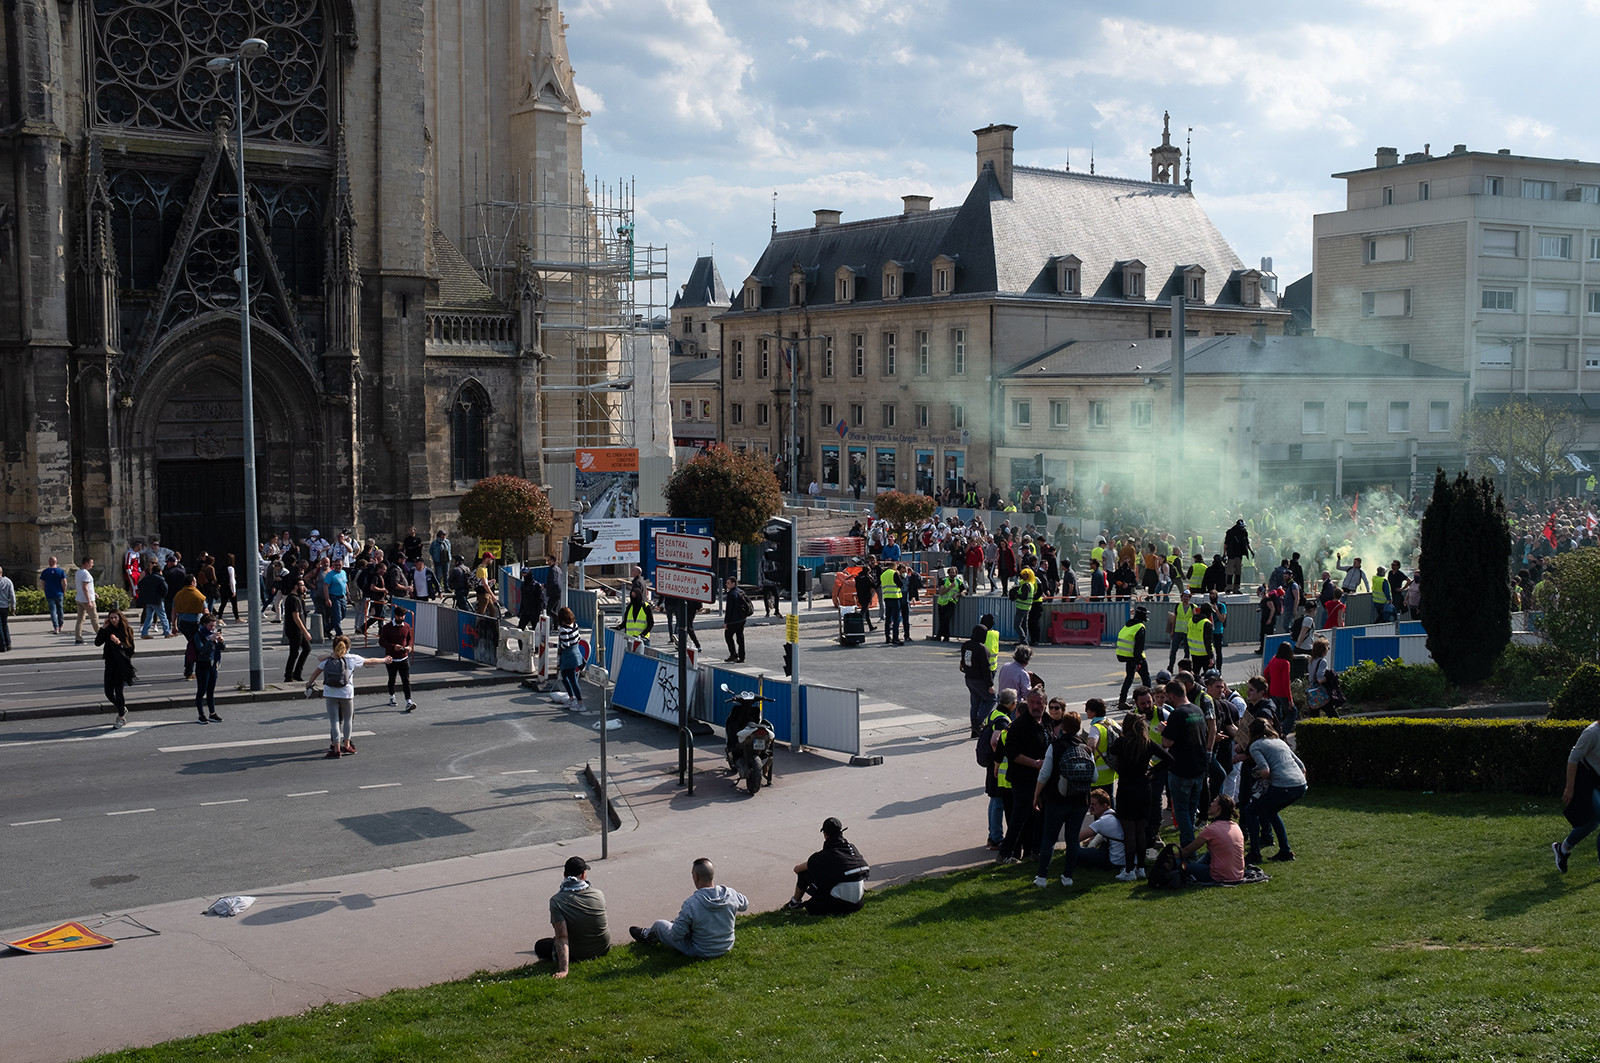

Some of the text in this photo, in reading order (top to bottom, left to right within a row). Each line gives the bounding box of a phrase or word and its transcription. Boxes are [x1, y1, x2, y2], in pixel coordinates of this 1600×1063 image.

[665, 539, 688, 549] CENTRAL
[665, 549, 693, 560] QUATRANS
[673, 574, 697, 585] DAUPHIN
[665, 583, 690, 594] FRANÇOIS
